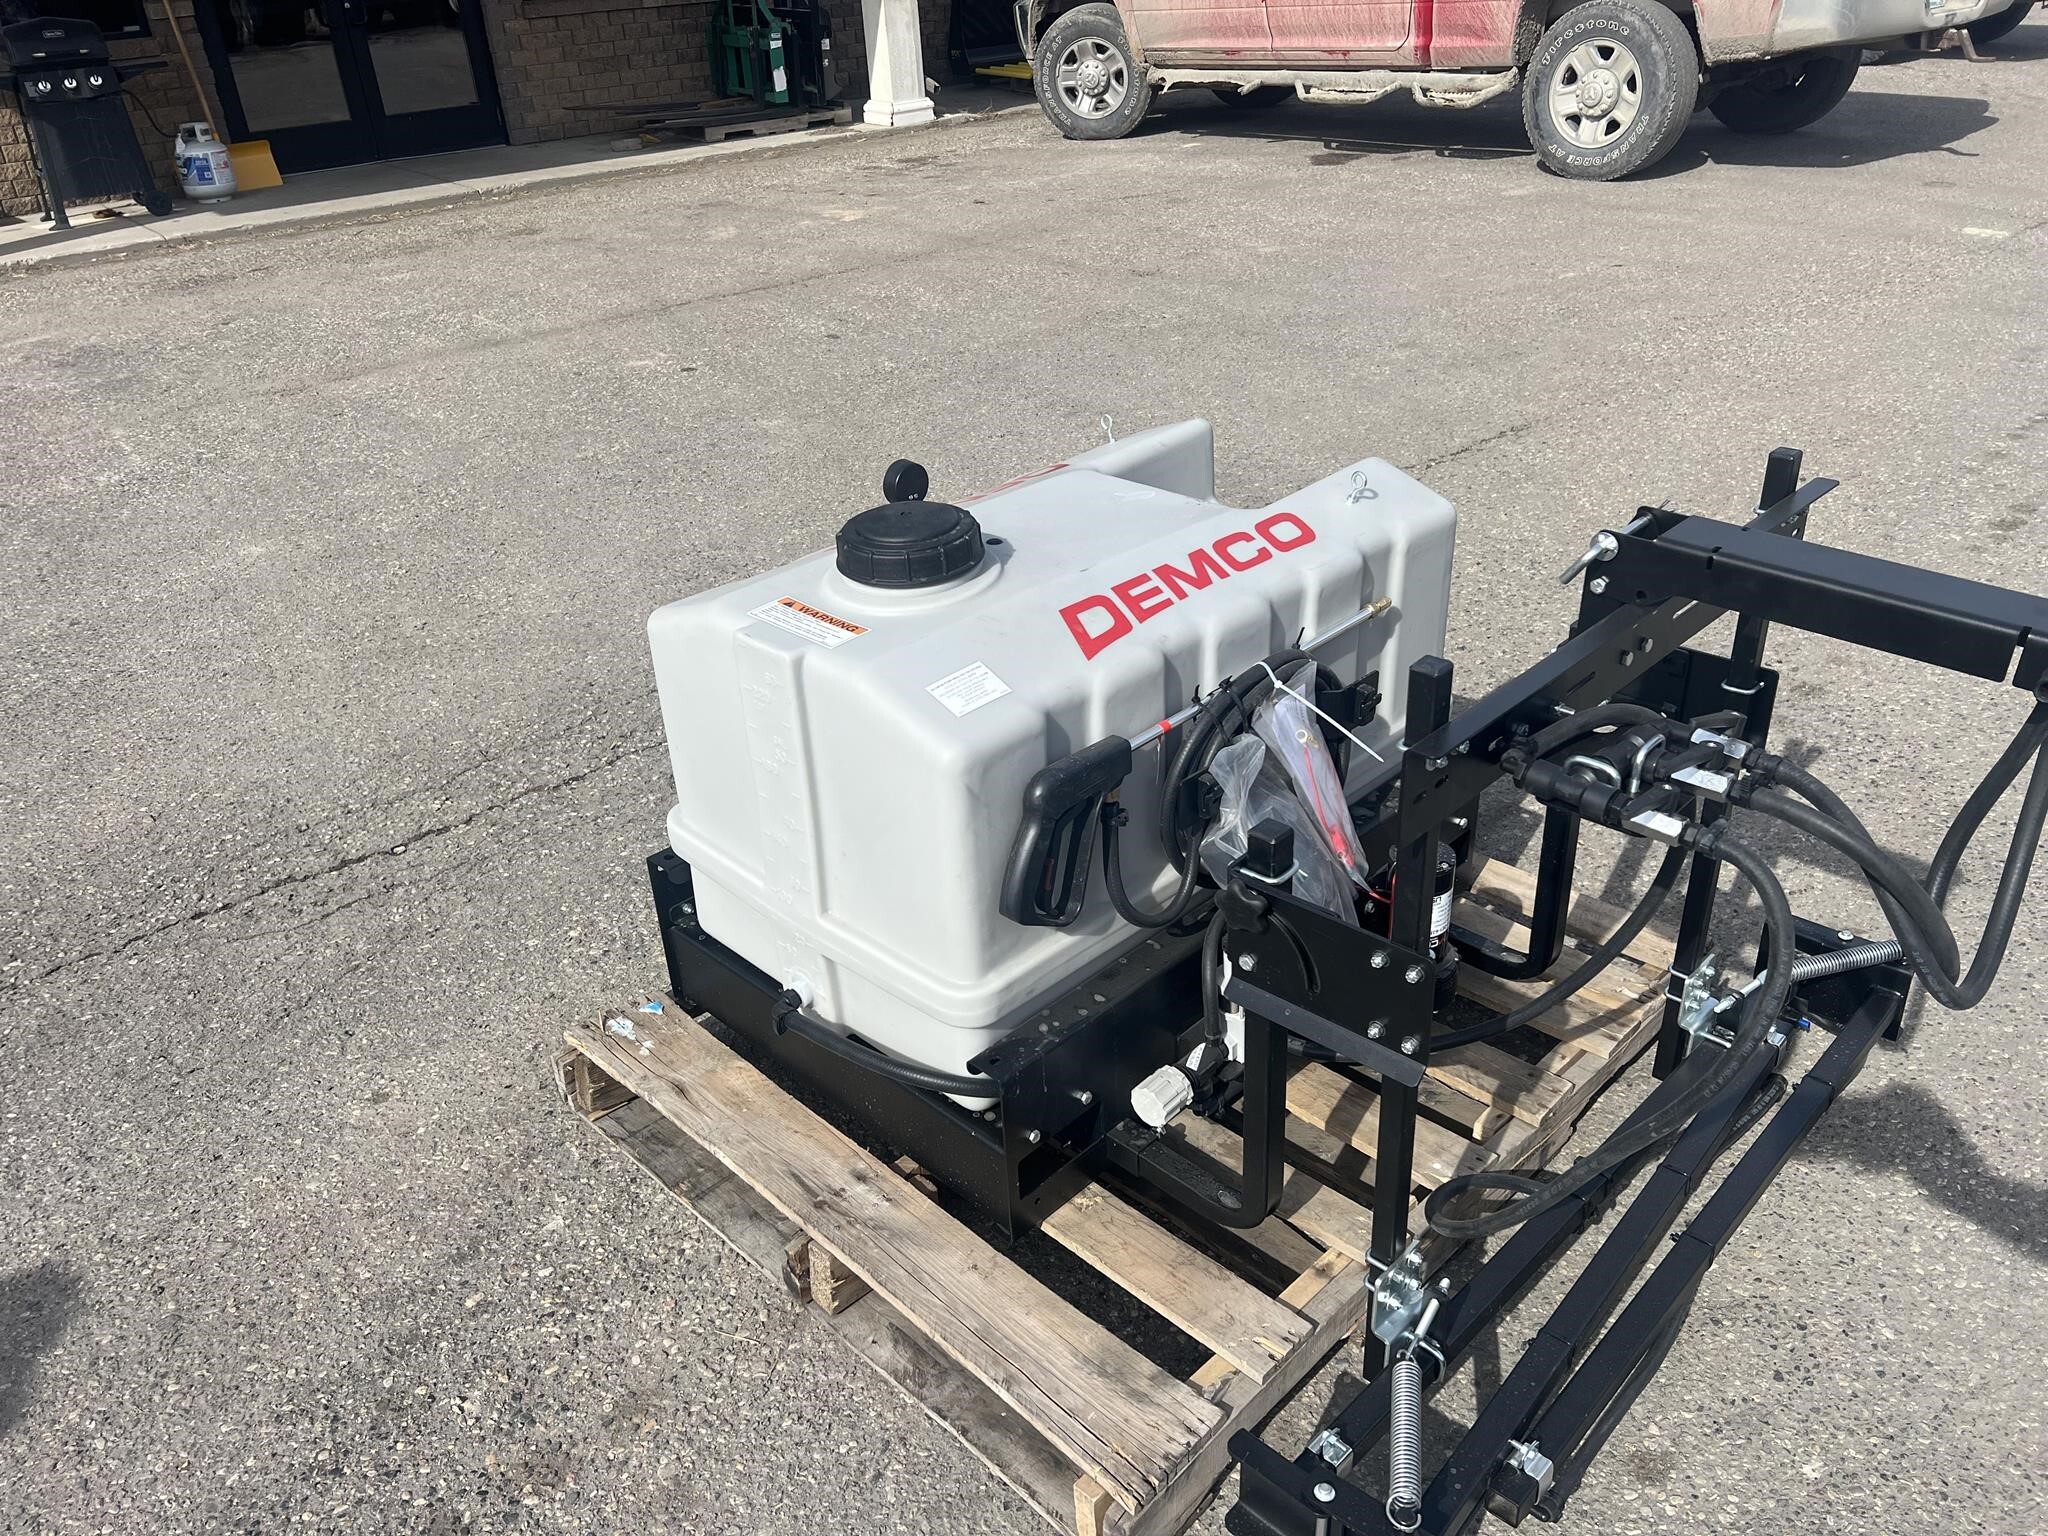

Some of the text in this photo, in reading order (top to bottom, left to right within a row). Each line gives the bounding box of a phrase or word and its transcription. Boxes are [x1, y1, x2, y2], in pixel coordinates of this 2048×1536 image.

[1541, 19, 1630, 65] Firestone
[1041, 35, 1072, 127] TRANSFORCE AT
[1548, 115, 1649, 166] TRANSFORCE AT
[1058, 512, 1316, 661] DEMCO
[798, 605, 859, 632] WARNING
